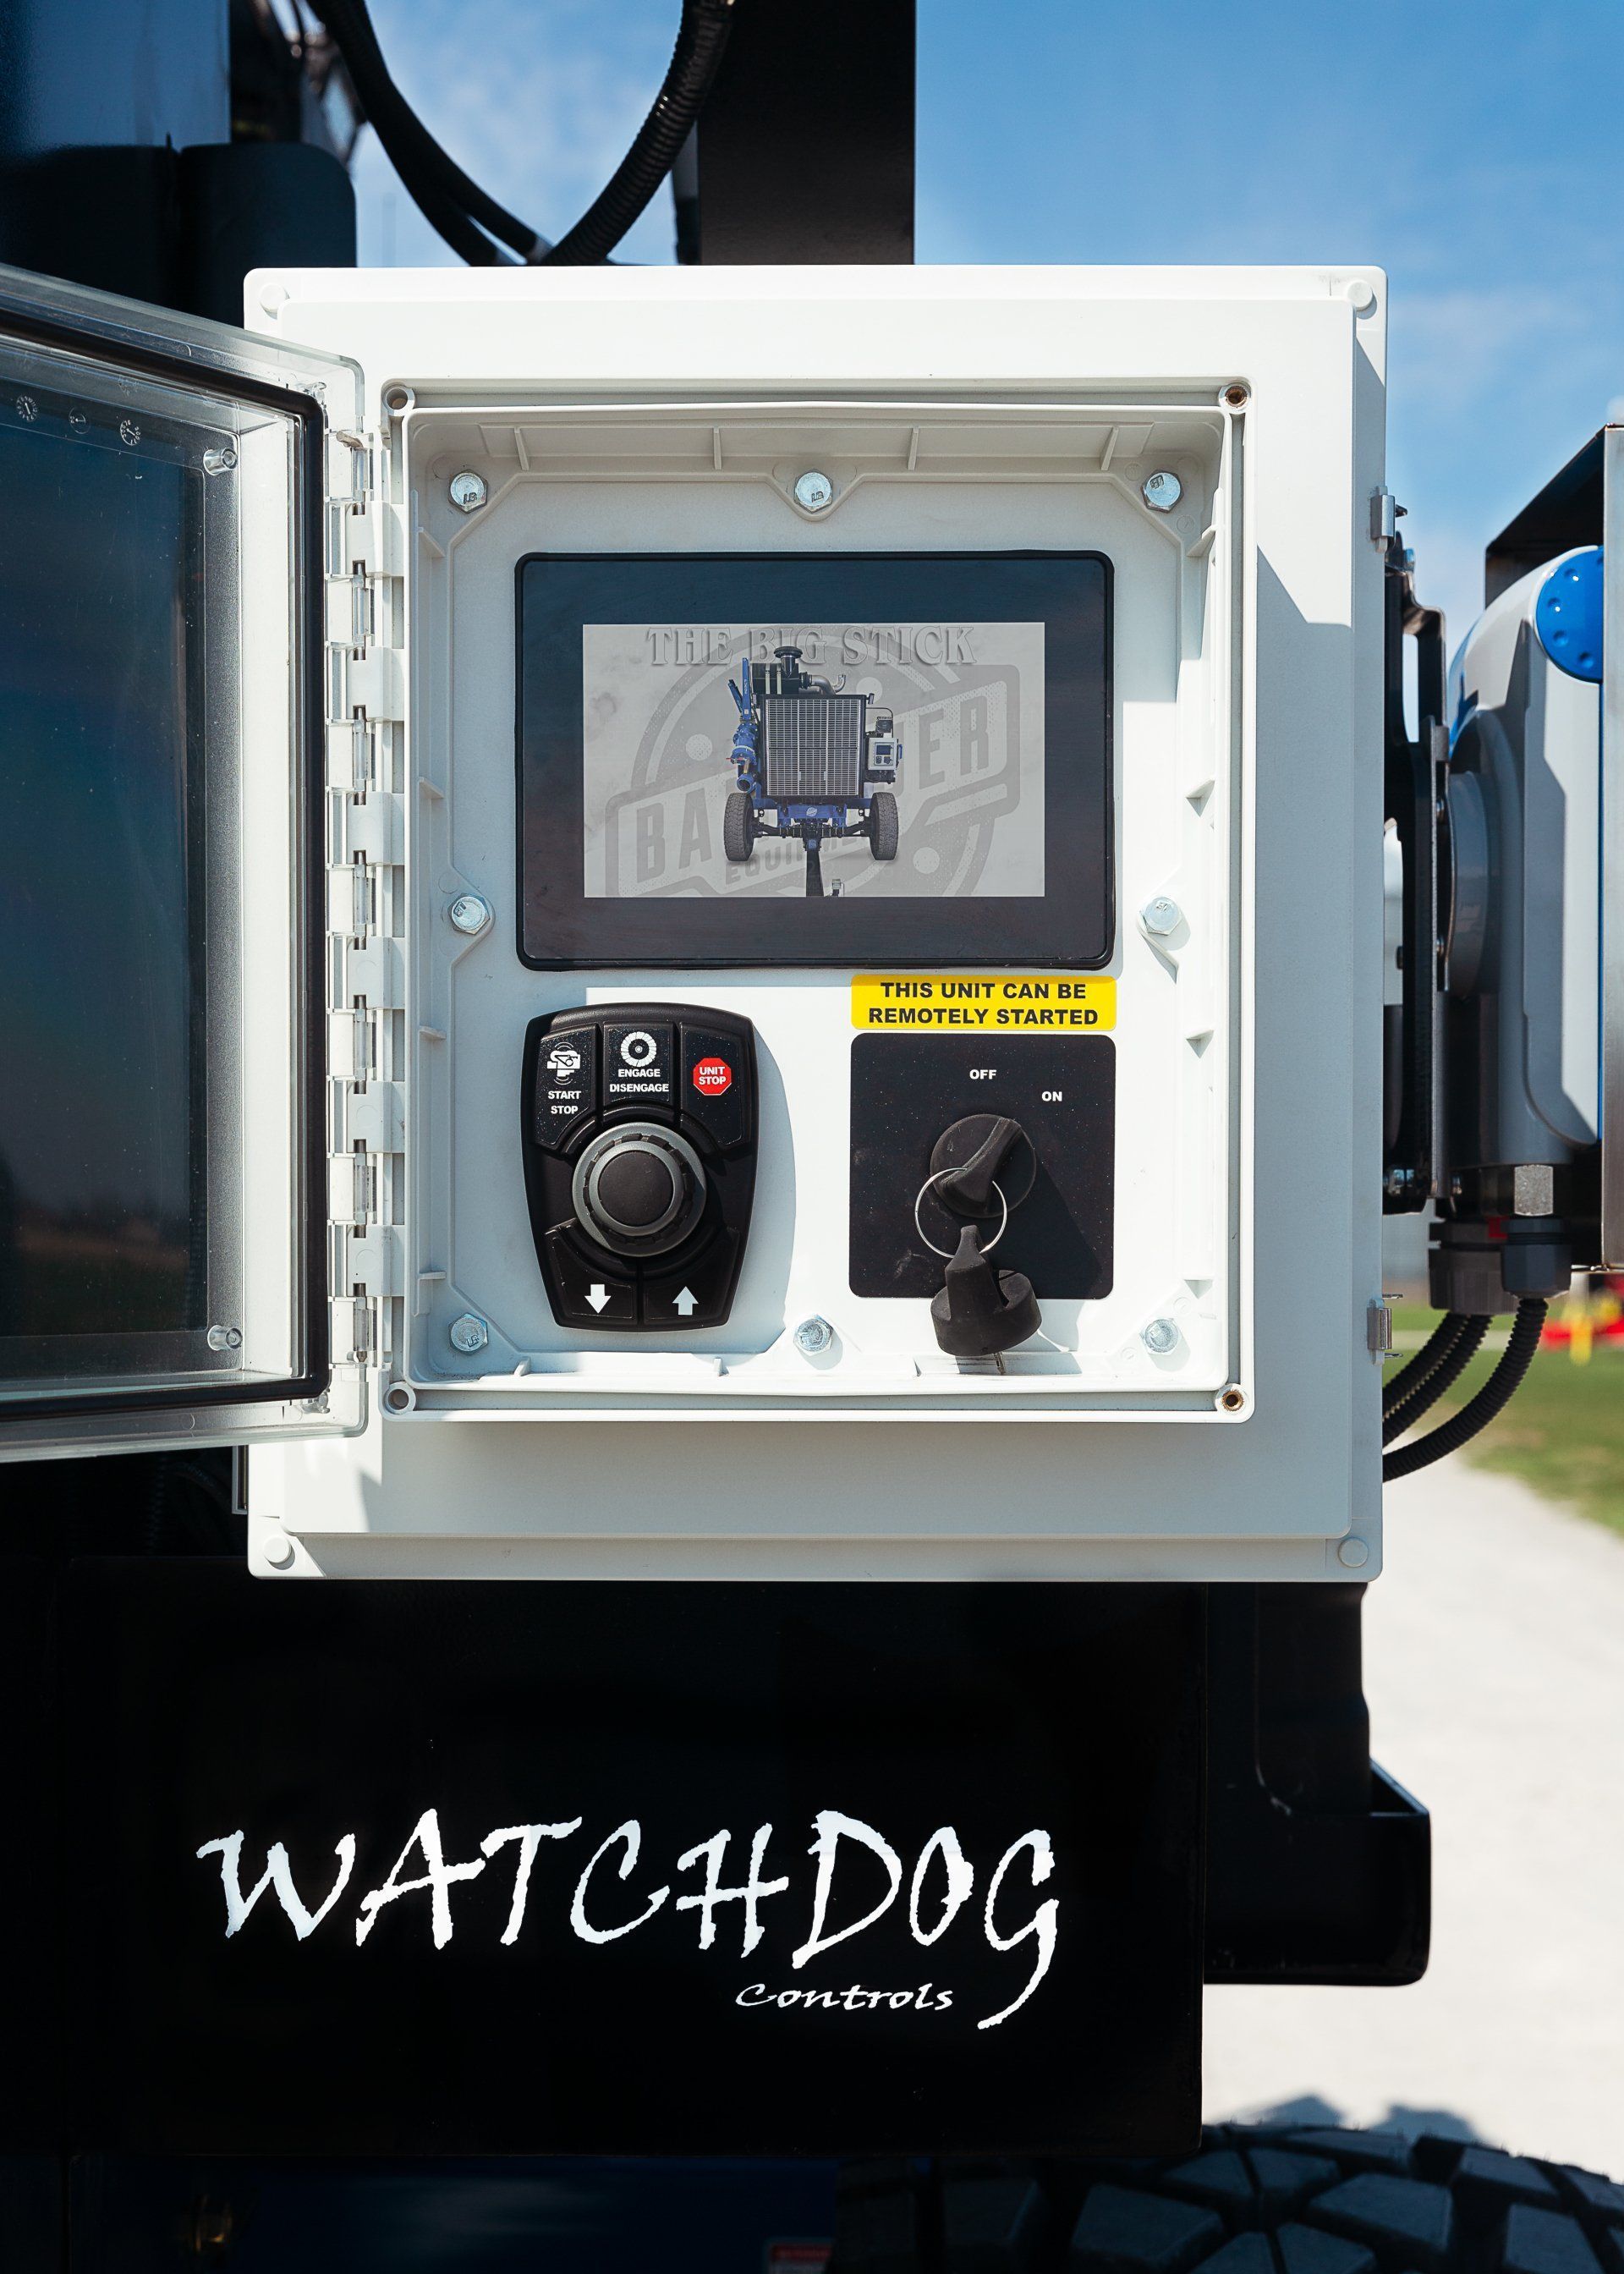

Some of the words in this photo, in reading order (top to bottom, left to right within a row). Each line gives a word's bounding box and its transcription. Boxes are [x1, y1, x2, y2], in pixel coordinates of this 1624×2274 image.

[646, 627, 733, 666] THE
[749, 626, 826, 666] BIG
[843, 625, 977, 665] STICK
[881, 982, 933, 998] THIS
[941, 982, 996, 999] UNIT
[1002, 982, 1049, 999] CAN
[1057, 983, 1086, 999] BE
[869, 1008, 989, 1024] REMOTELY
[996, 1008, 1098, 1025] STARTED
[617, 1068, 661, 1078] ENGAGE
[699, 1066, 726, 1075] UNIT
[969, 1068, 997, 1080] OFF
[698, 1075, 727, 1085] STOP
[609, 1083, 670, 1093] DISENGAGE
[547, 1090, 582, 1100] START
[1041, 1090, 1062, 1102] ON
[550, 1105, 579, 1115] STOP
[196, 1808, 1060, 2030] WATCHDOG
[735, 1982, 953, 2011] Controls
